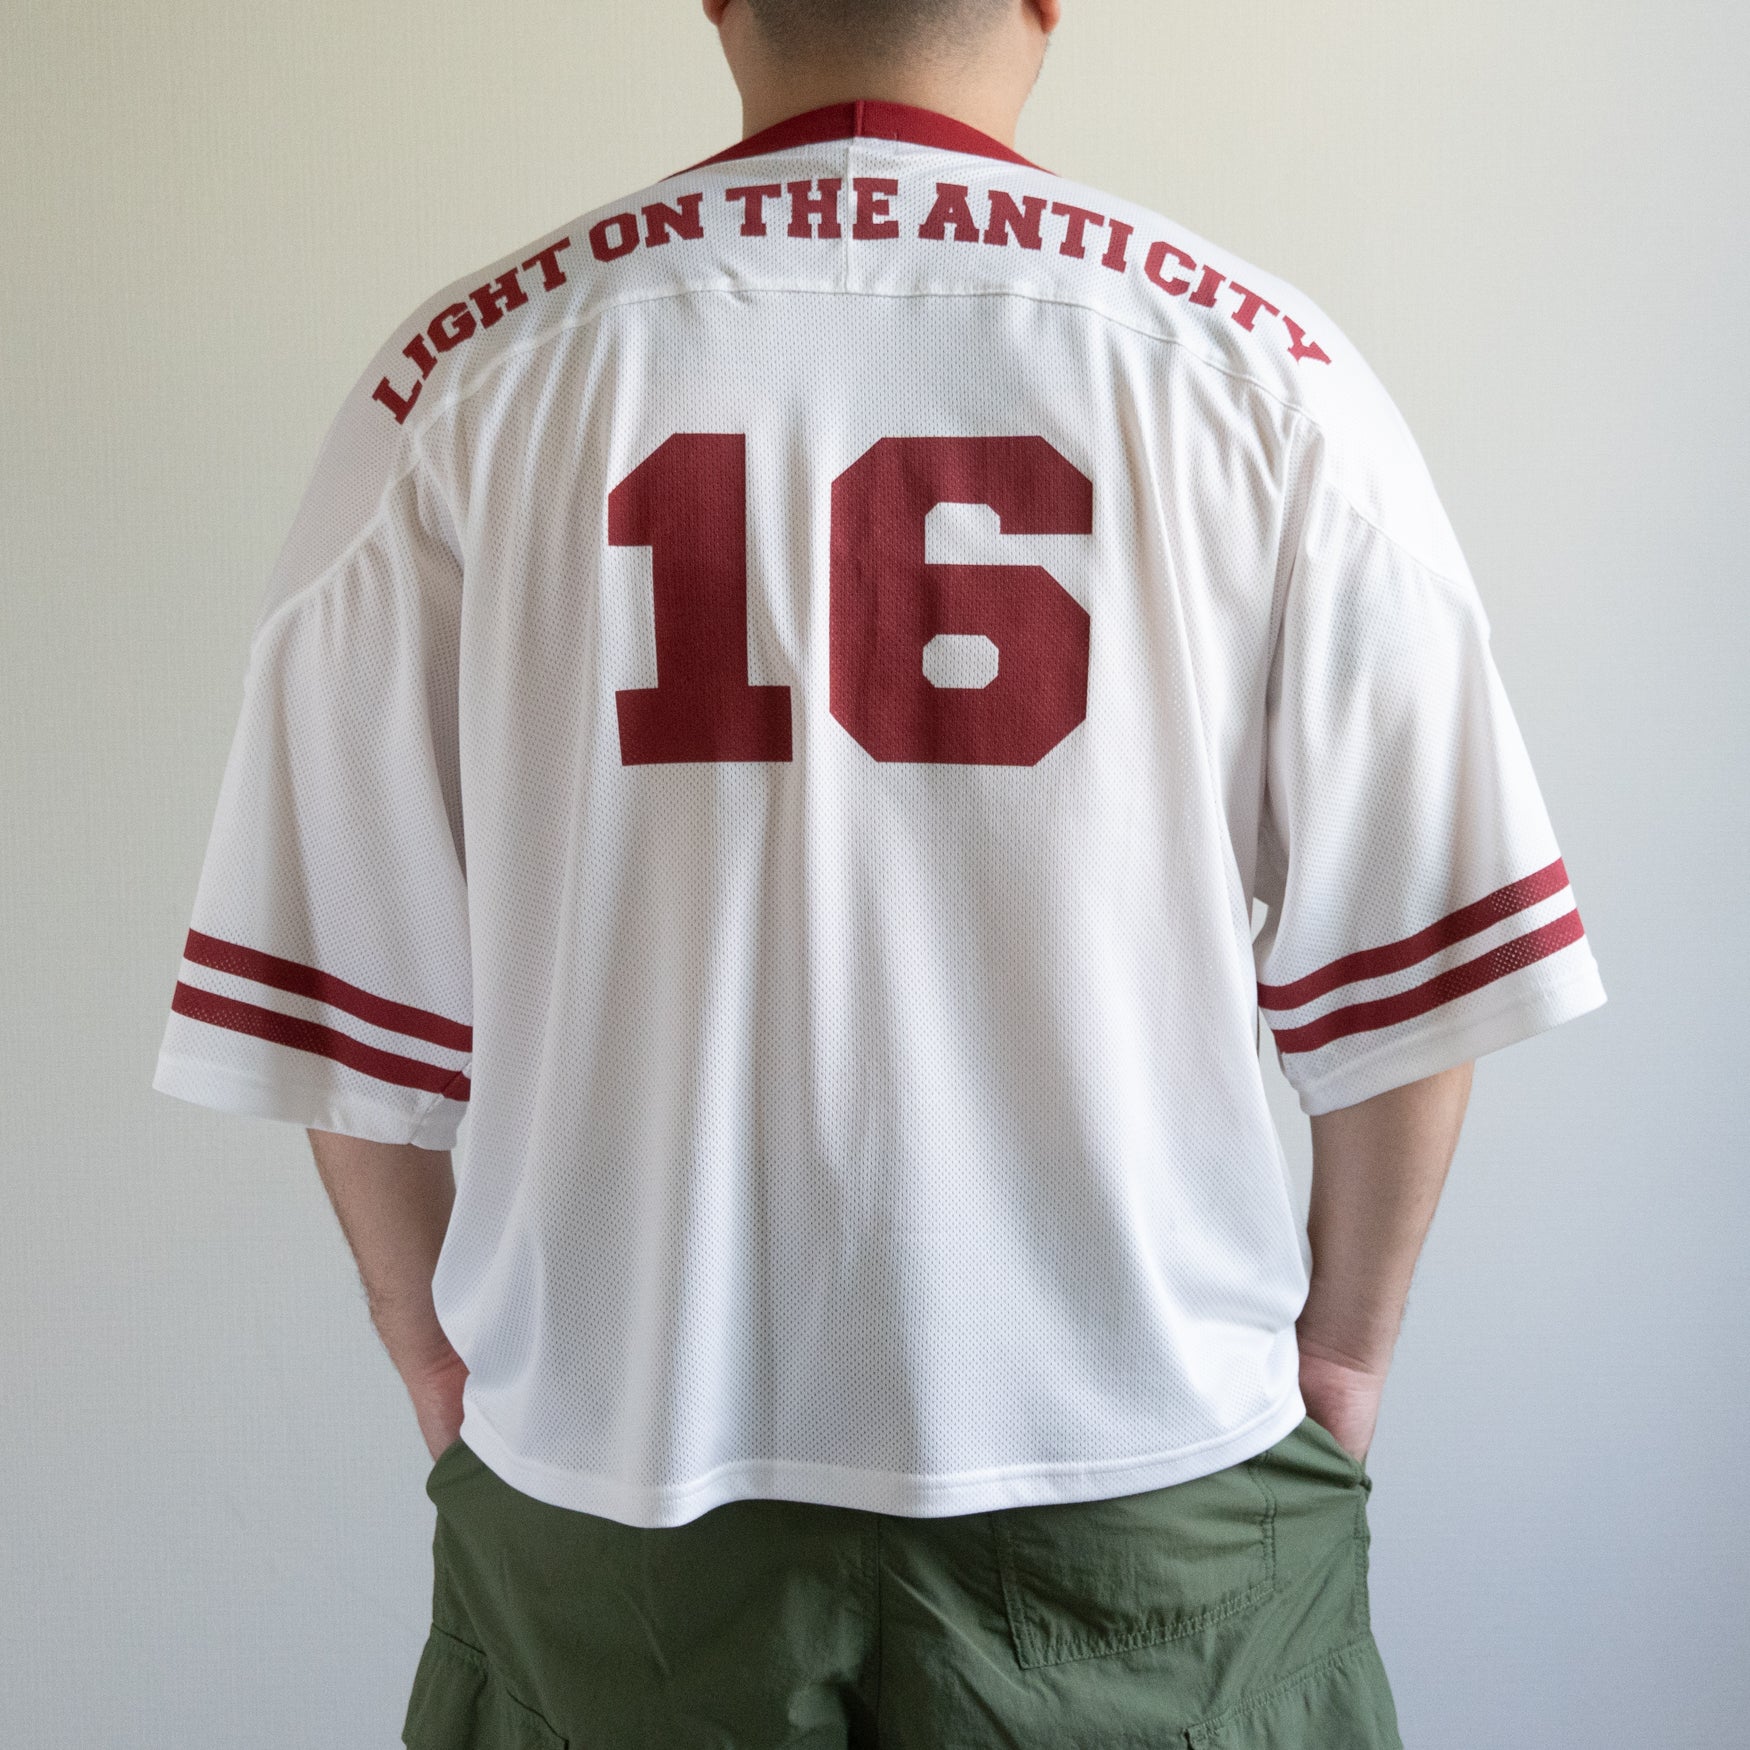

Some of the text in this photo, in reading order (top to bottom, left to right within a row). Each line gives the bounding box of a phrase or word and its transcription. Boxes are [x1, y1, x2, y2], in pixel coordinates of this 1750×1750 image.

[372, 177, 1332, 425] LIGHT ON THE ANTI CITY
[608, 433, 1093, 767] 16
